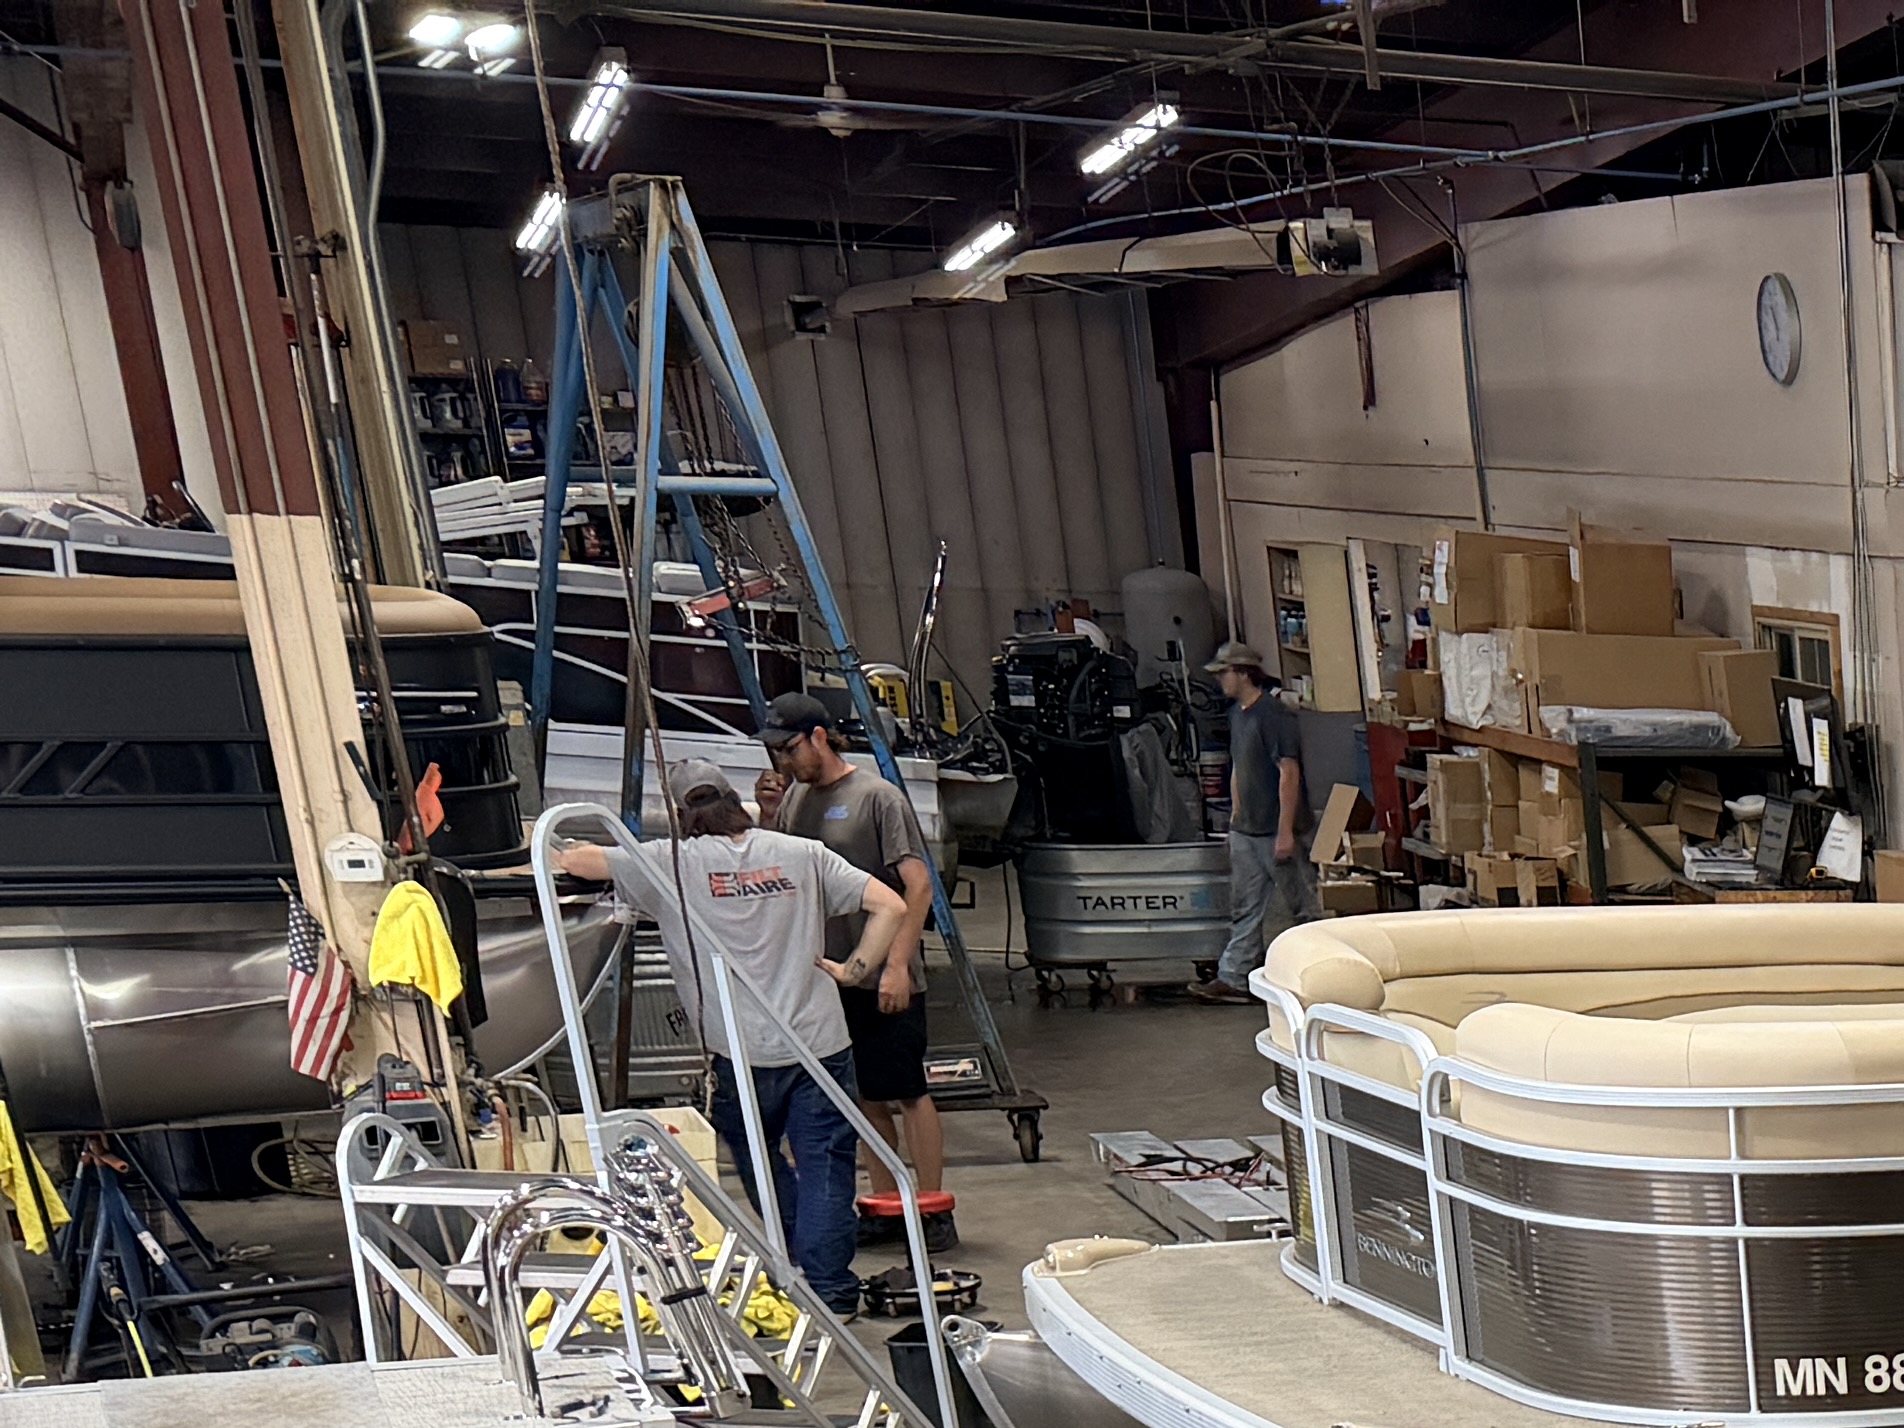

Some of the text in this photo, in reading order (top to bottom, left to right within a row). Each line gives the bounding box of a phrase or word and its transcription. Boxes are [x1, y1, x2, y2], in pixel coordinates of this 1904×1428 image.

[742, 877, 796, 897] AIRE
[1076, 895, 1179, 911] TARTER
[1357, 1232, 1436, 1279] BENNINGTO
[1773, 1356, 1849, 1397] MN
